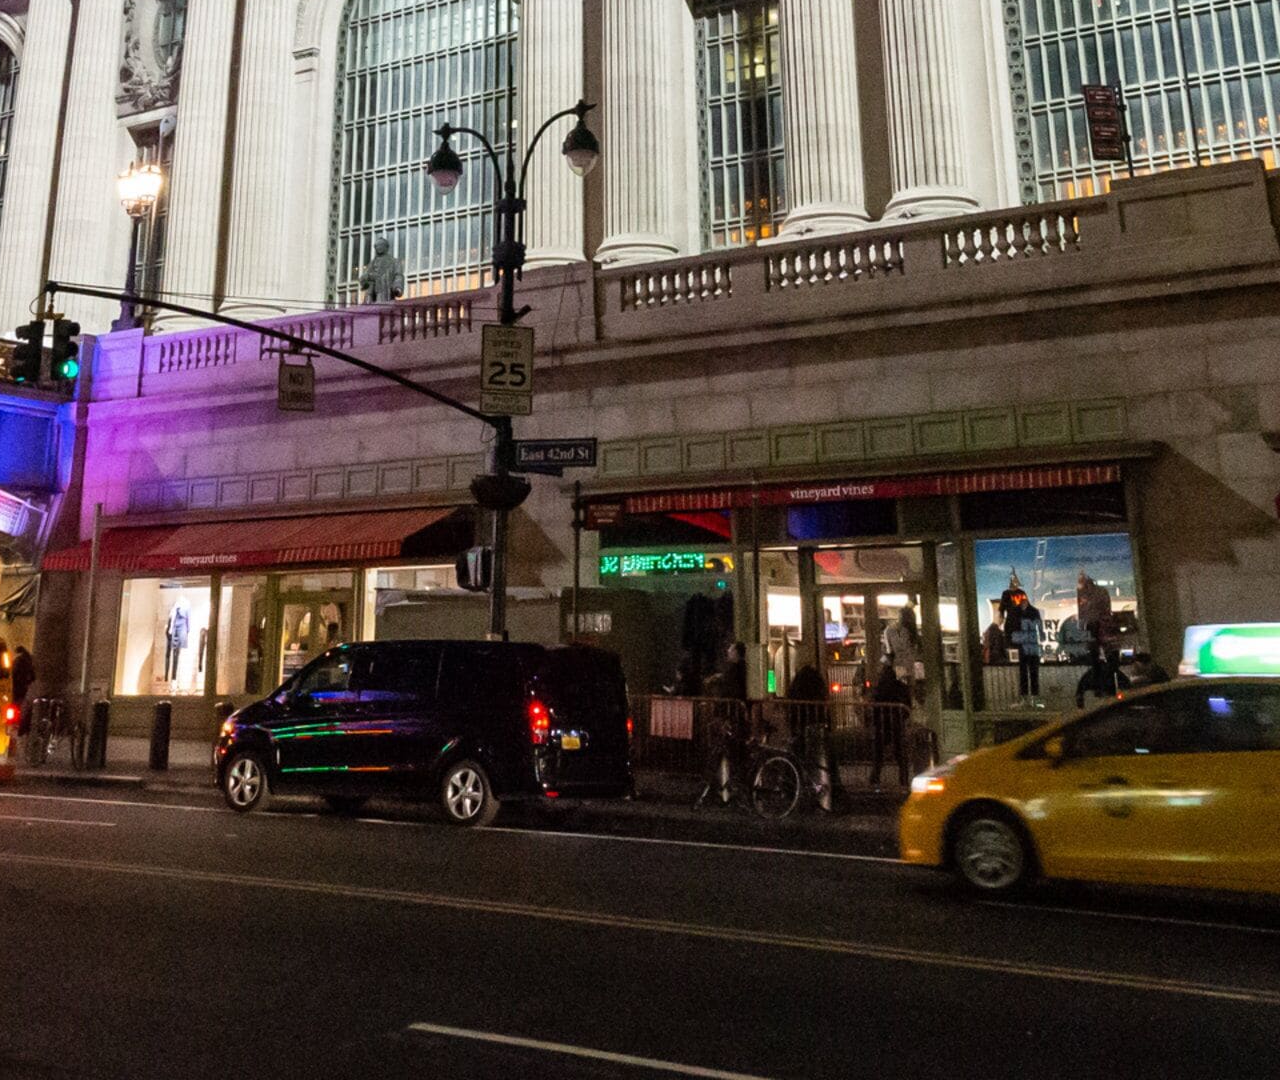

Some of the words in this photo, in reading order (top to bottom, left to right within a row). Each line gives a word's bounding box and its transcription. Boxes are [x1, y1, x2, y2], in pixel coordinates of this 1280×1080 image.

[289, 373, 304, 386] NO
[488, 361, 527, 387] 25
[521, 447, 545, 461] East
[547, 447, 575, 460] 42nd
[577, 446, 590, 459] St
[790, 485, 841, 501] vineyard
[842, 483, 875, 496] vines
